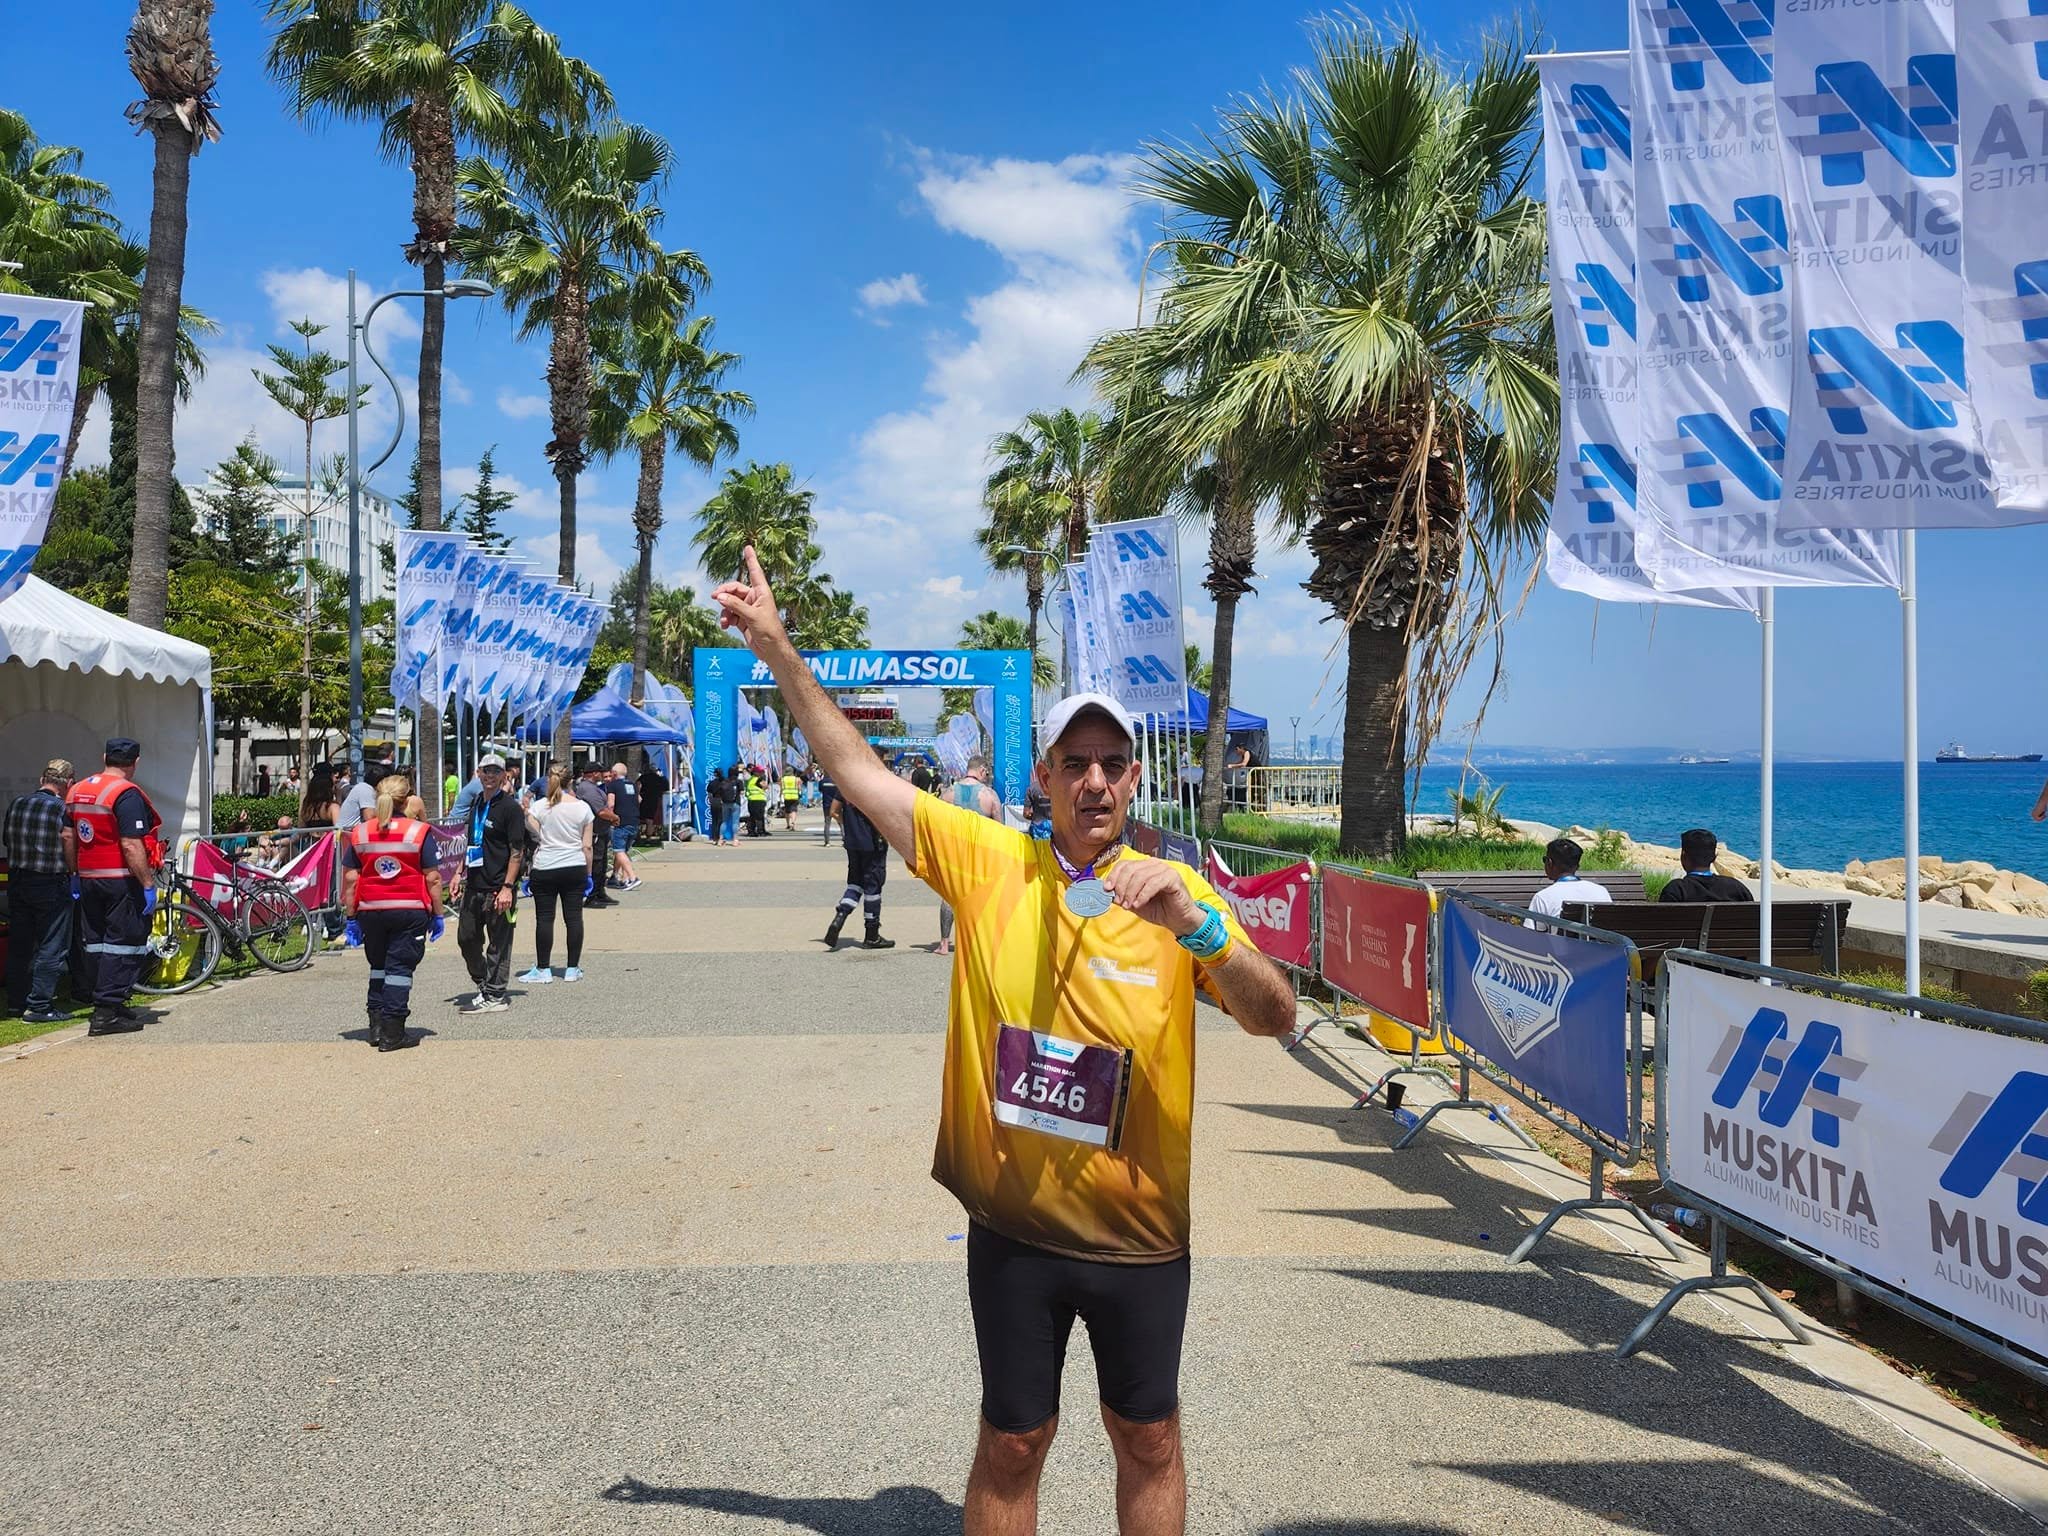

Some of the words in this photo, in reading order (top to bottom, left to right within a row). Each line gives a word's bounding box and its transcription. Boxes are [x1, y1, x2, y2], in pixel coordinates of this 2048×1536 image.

[751, 656, 975, 681] #NLIMASSOL
[1361, 934, 1388, 955] DASHIN'S
[1362, 950, 1391, 969] FOUNDATION
[1483, 948, 1559, 1007] PETROLINA
[1031, 1061, 1061, 1074] MARATHON
[1061, 1068, 1076, 1078] RACE
[1011, 1071, 1087, 1113] 4546
[1704, 1112, 1878, 1227] MUSKITA
[1704, 1159, 1782, 1207] ALUMINIUM
[1784, 1197, 1880, 1249] INDUSTRIES
